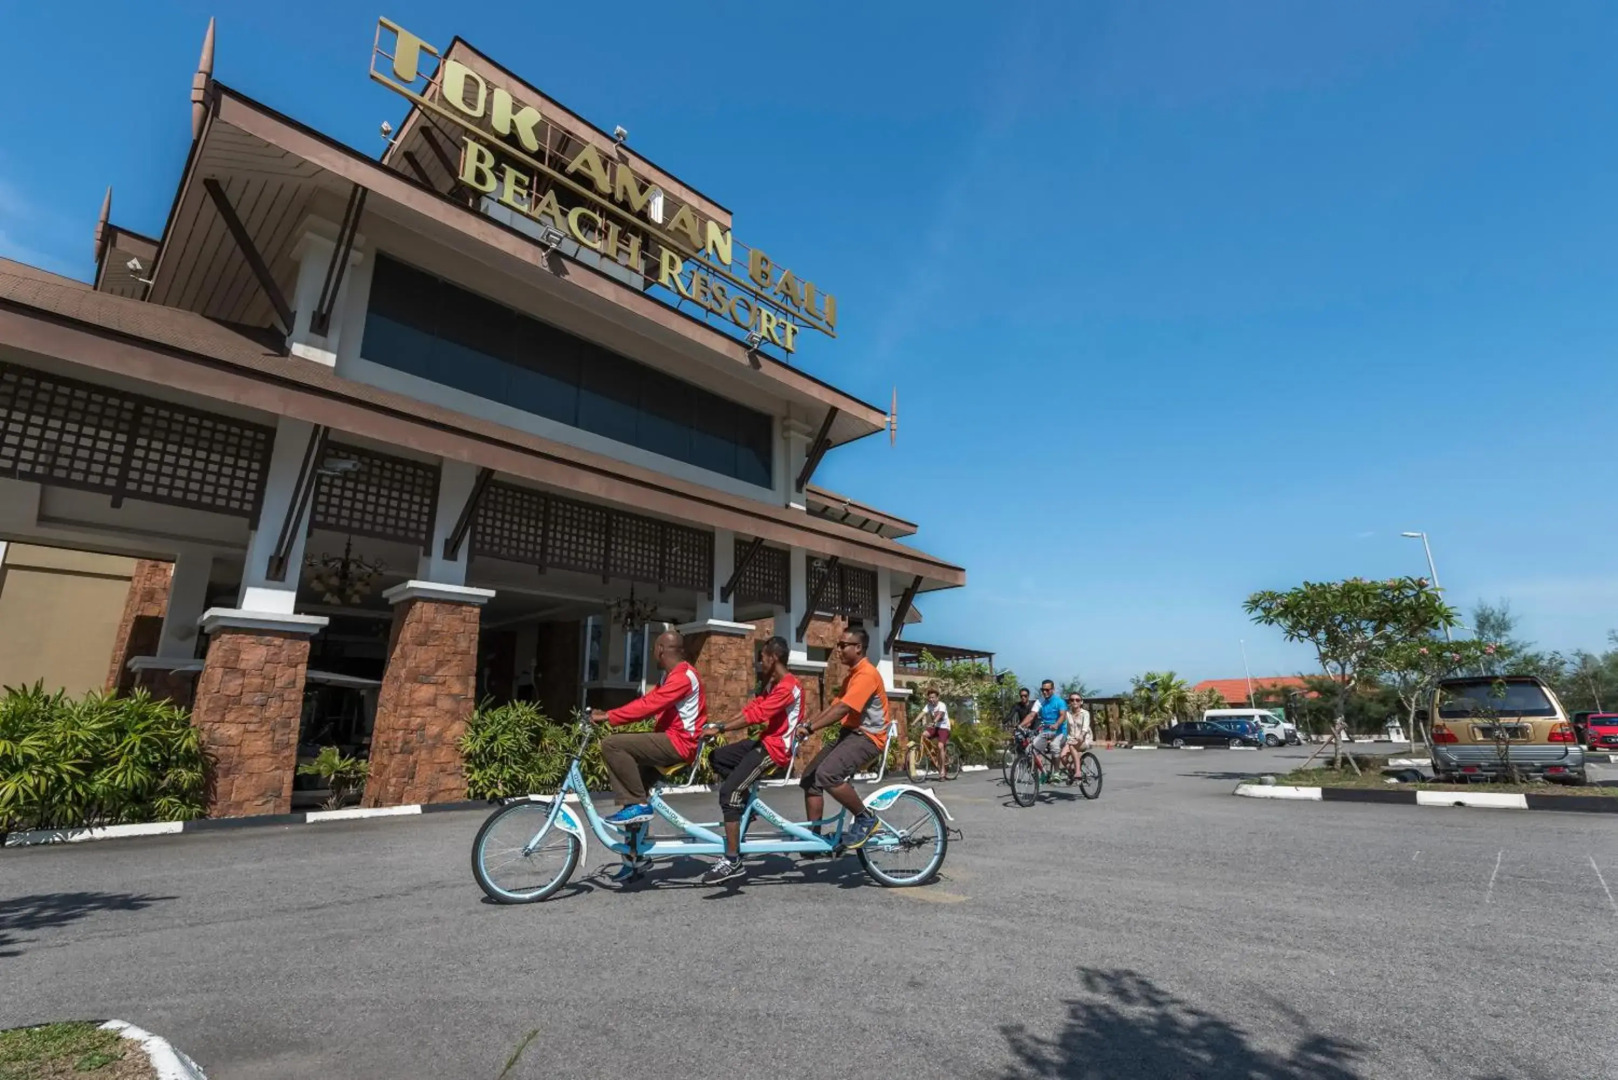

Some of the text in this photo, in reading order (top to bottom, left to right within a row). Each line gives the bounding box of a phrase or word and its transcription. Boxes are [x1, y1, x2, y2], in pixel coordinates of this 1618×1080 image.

[379, 16, 836, 328] TOK AMAN BALI
[458, 136, 799, 354] BEACH RESORT
